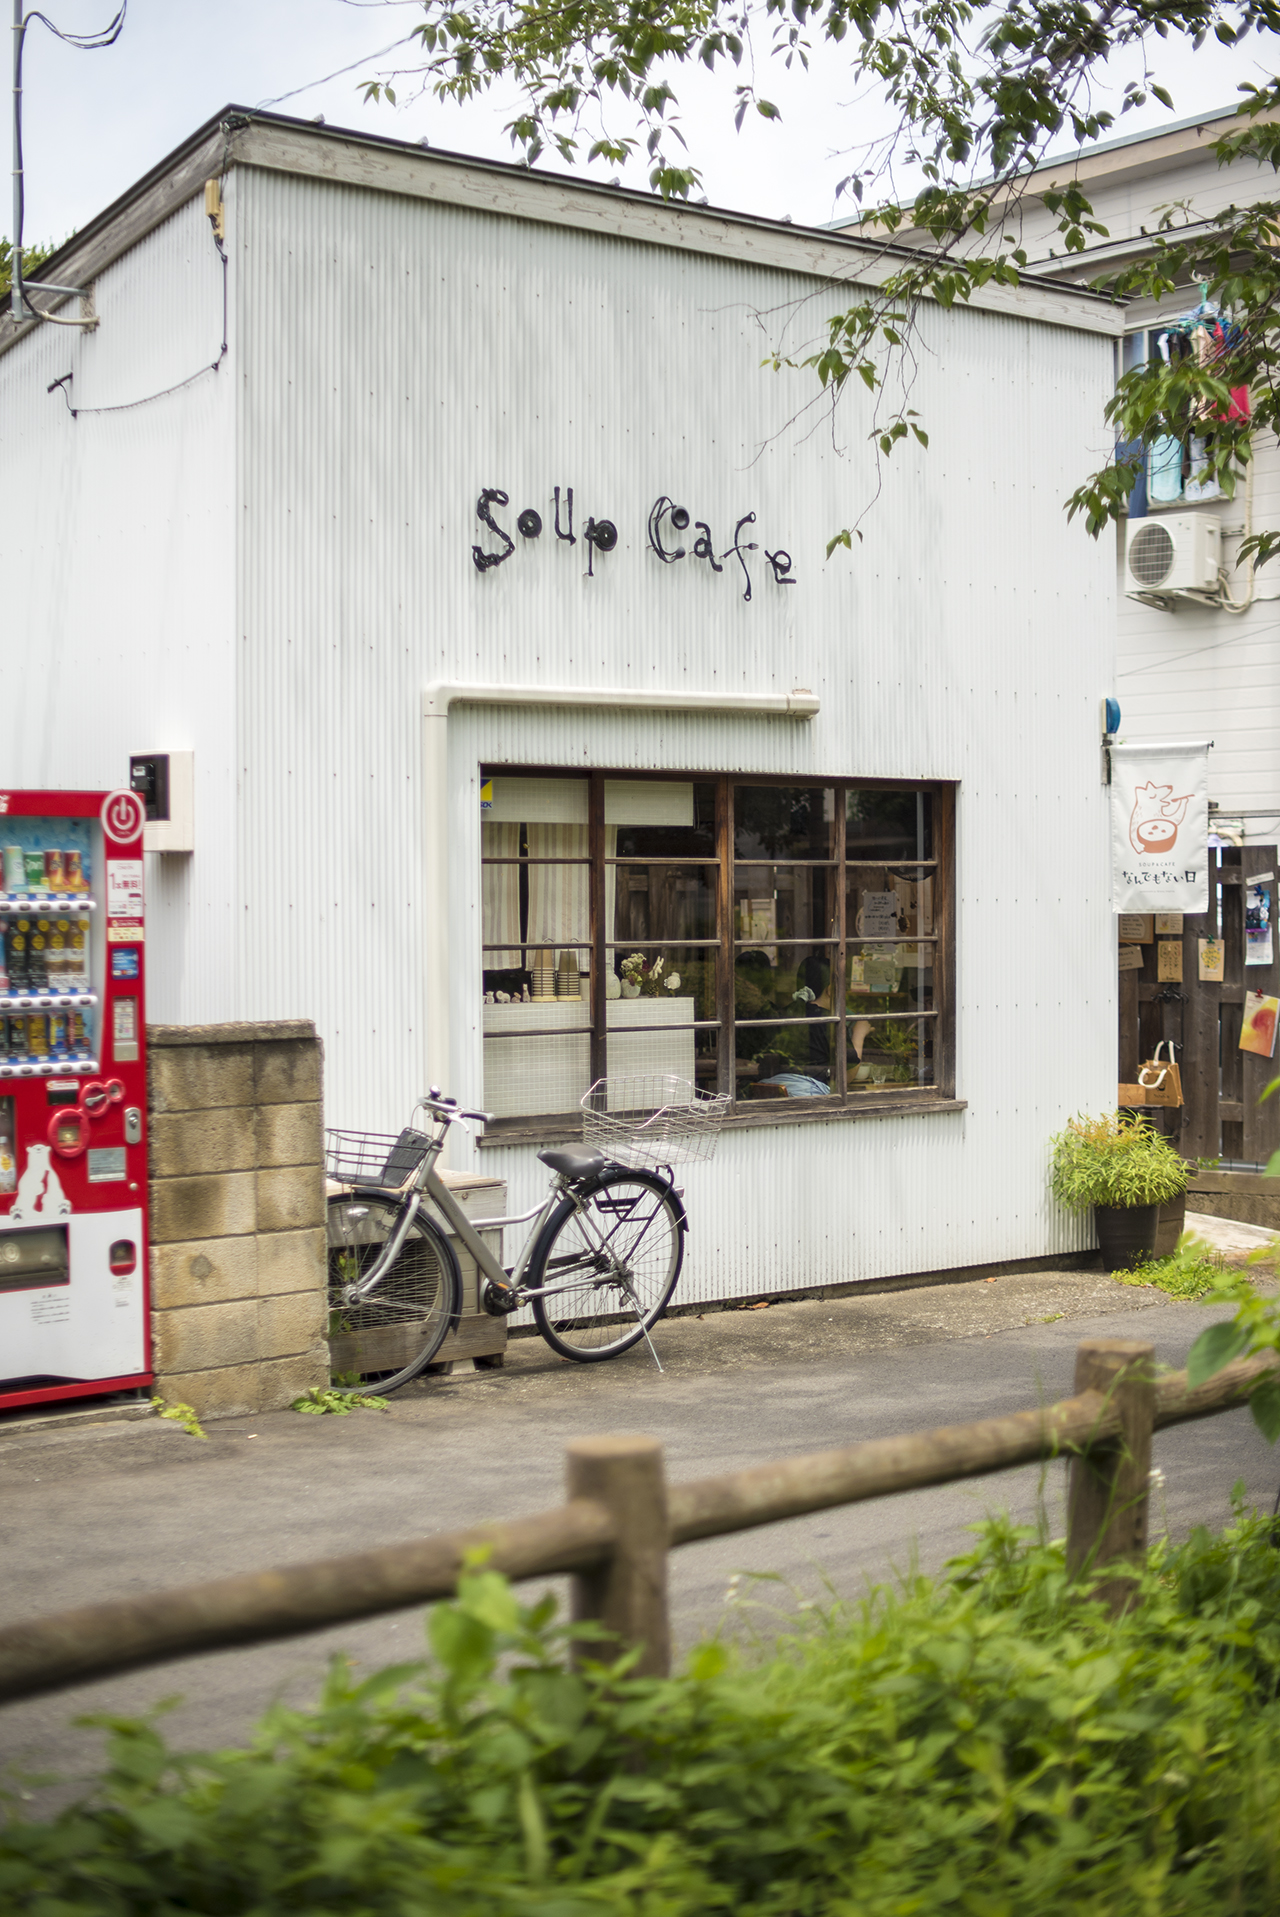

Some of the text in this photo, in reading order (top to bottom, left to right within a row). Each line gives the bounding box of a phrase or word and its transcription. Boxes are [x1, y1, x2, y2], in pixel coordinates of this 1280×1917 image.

[648, 496, 797, 601] Cafe
[1122, 870, 1197, 885] なんでもない日
